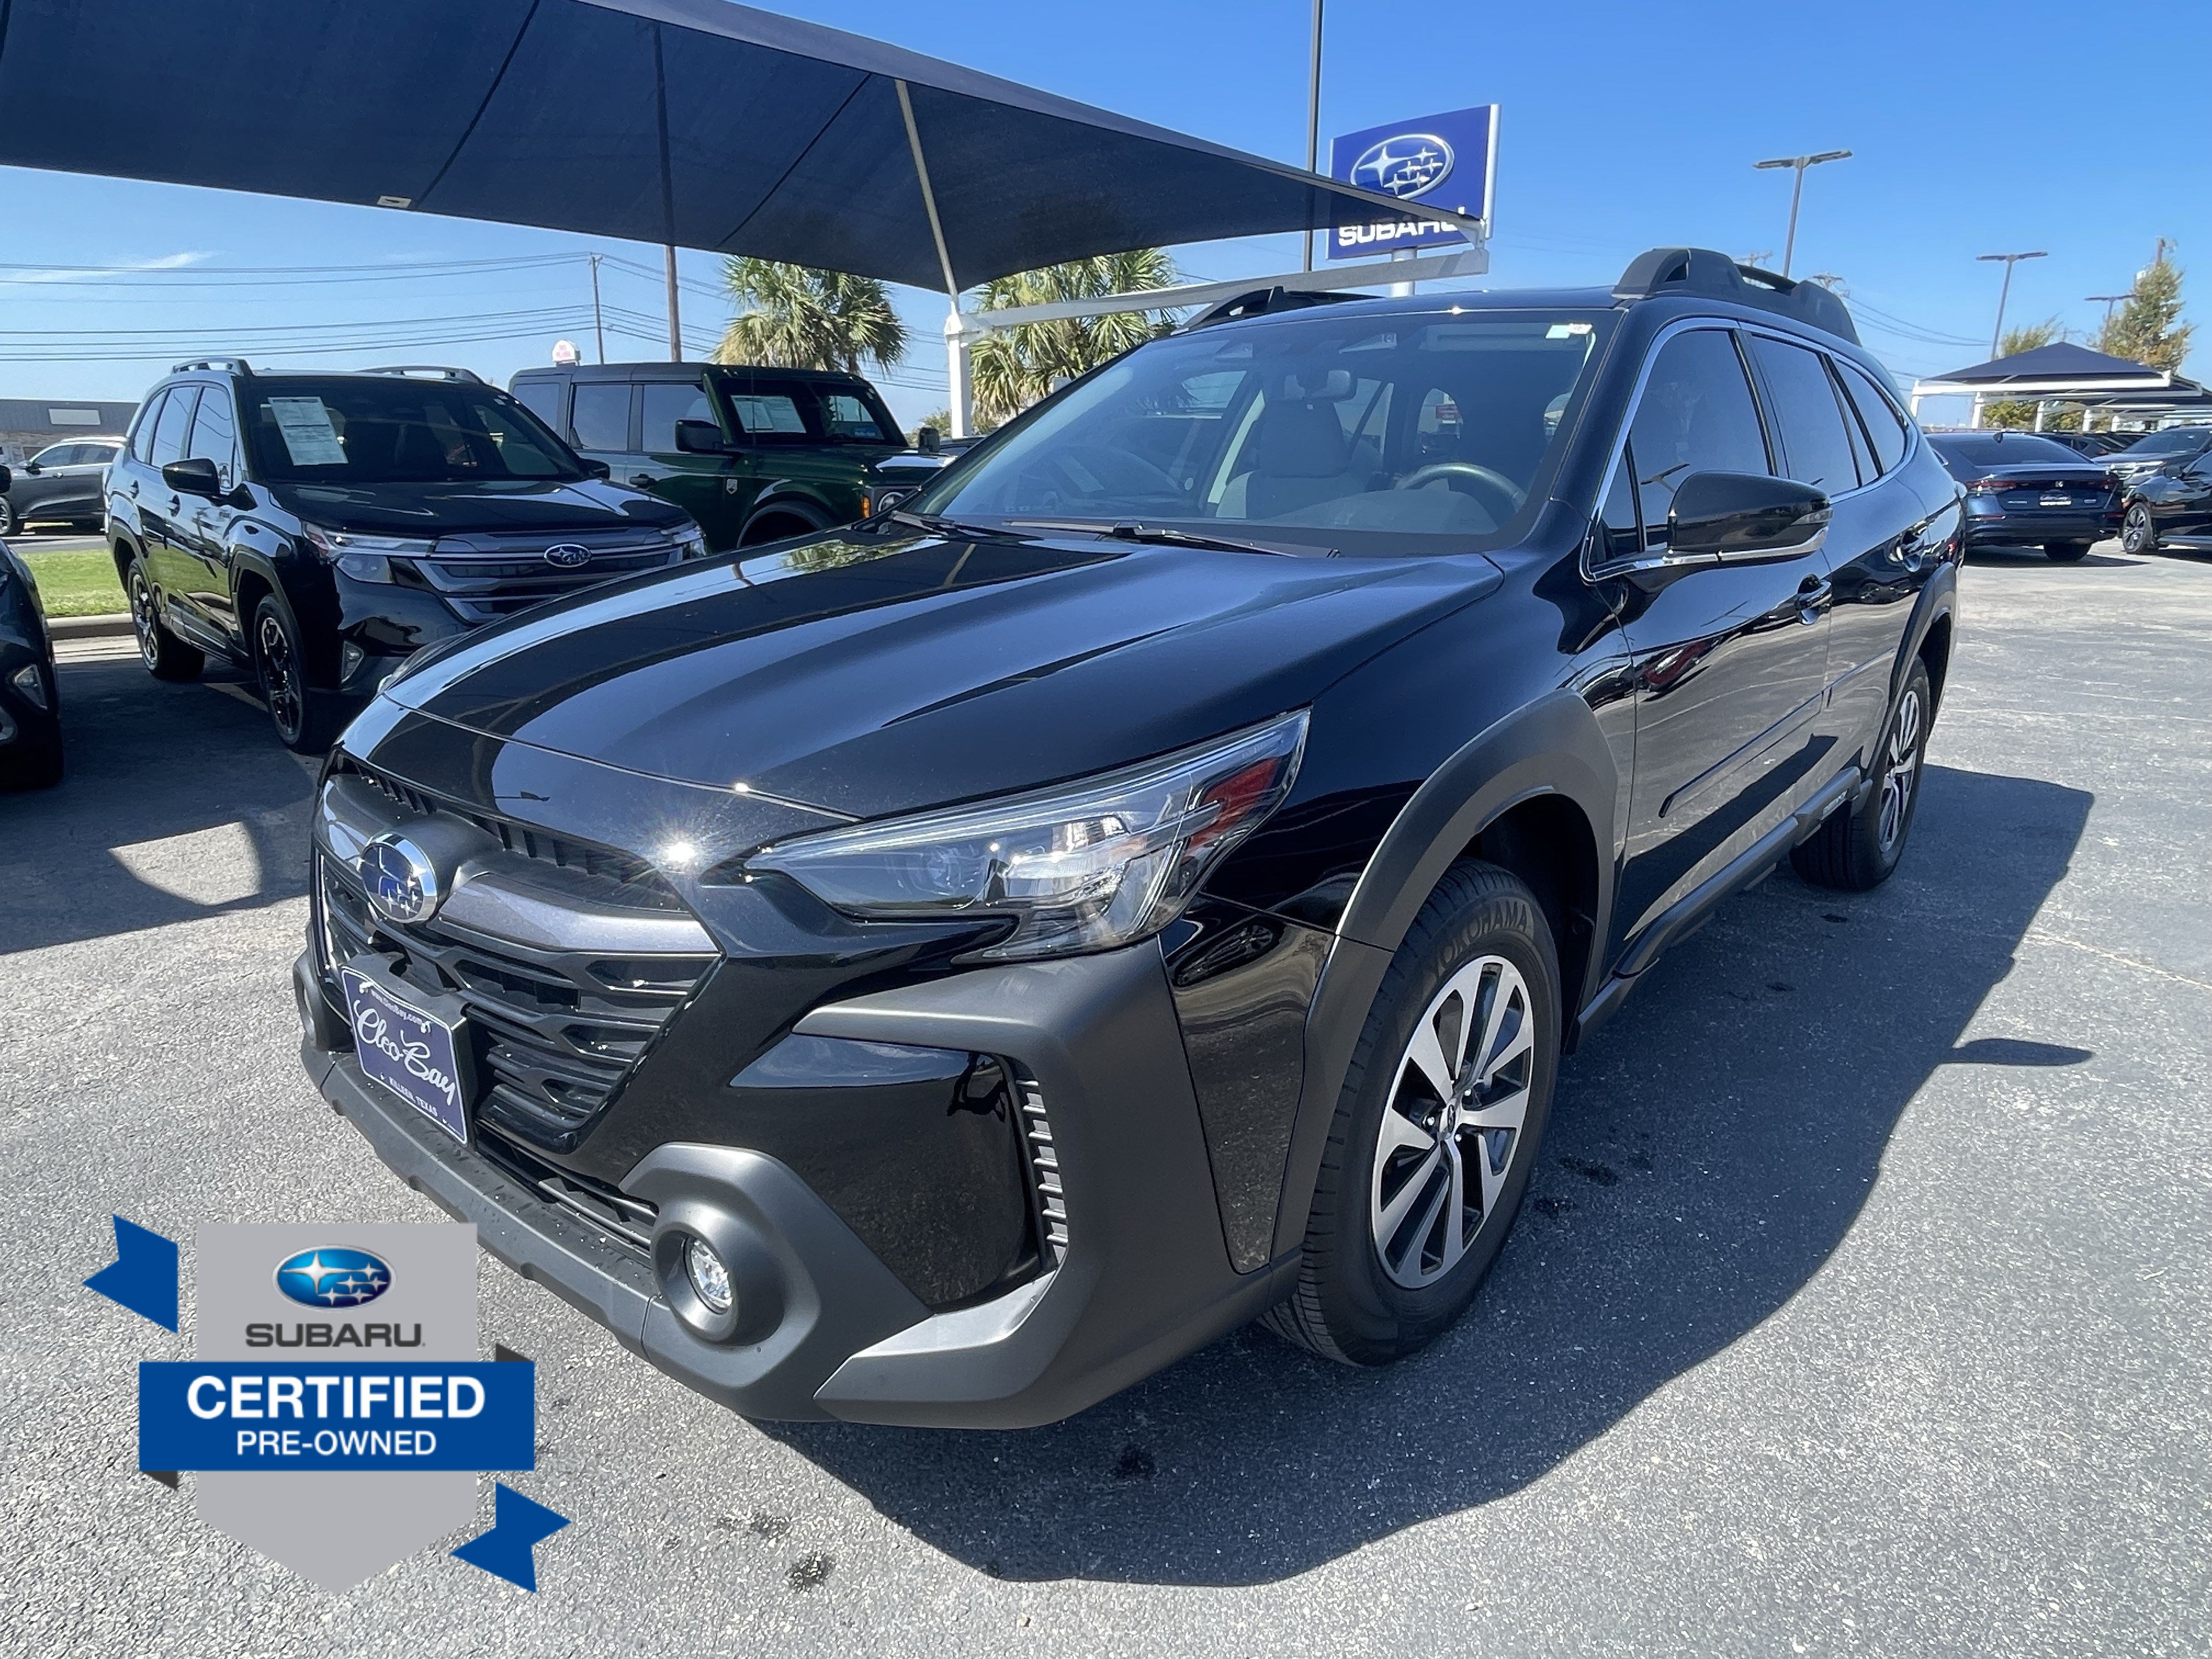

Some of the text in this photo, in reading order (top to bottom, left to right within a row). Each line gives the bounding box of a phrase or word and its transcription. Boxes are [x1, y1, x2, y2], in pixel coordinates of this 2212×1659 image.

[1435, 900, 1527, 979] YOKOHAMA
[353, 1000, 456, 1106] Cleo Bay
[416, 1096, 438, 1117] TEXAS
